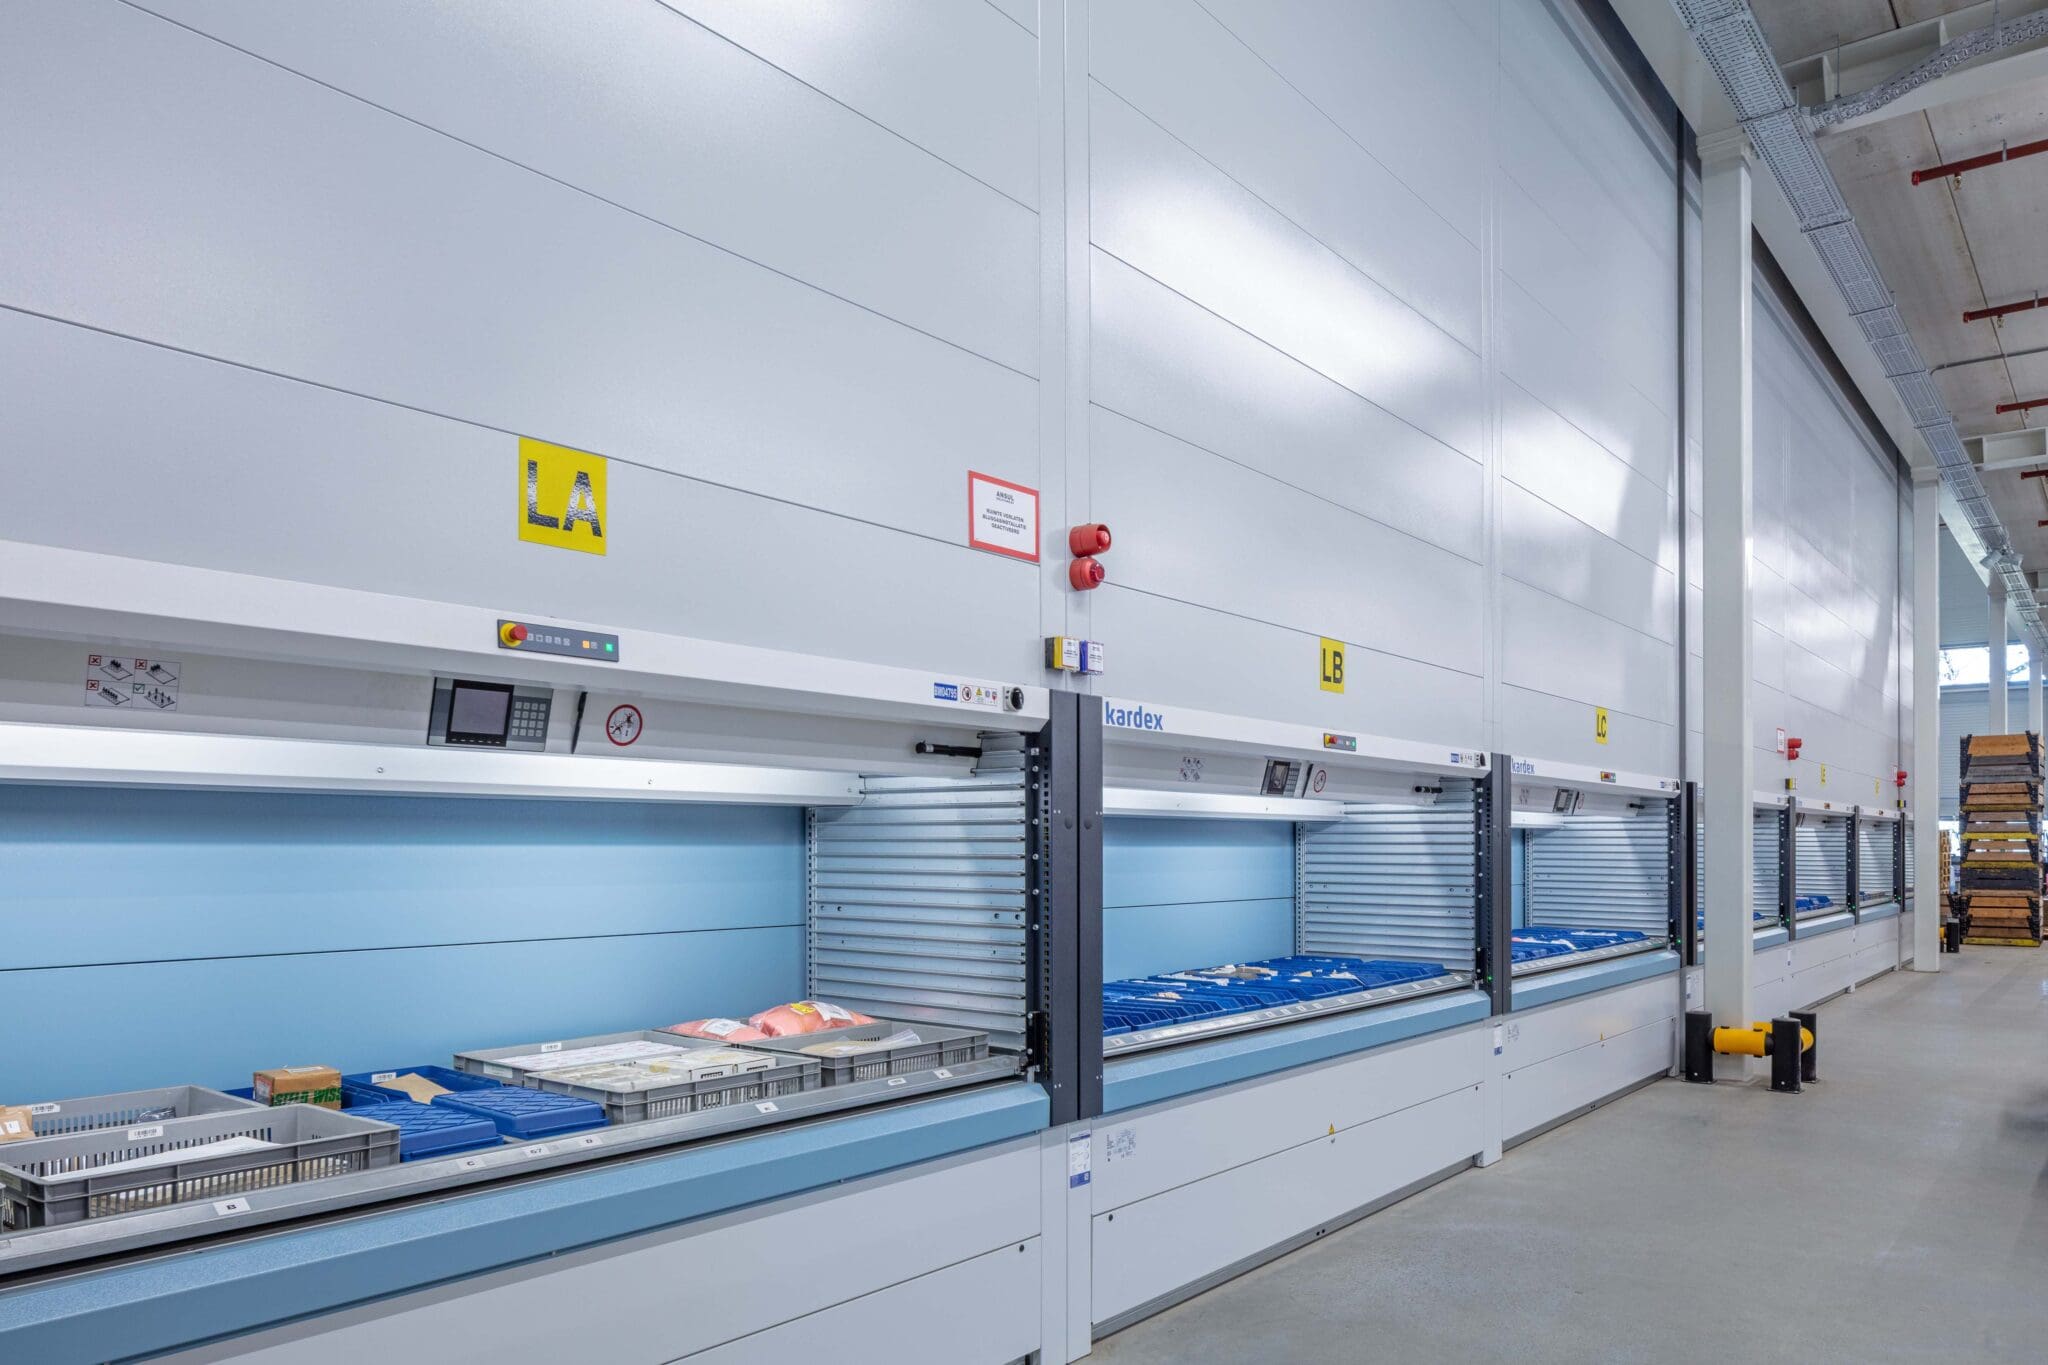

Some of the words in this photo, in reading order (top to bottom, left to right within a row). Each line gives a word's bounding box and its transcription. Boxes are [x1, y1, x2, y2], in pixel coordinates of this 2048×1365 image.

[527, 459, 603, 538] LA
[1322, 648, 1343, 684] LB
[1105, 701, 1163, 731] kardex
[1597, 714, 1607, 738] LC
[1511, 757, 1535, 775] kardex
